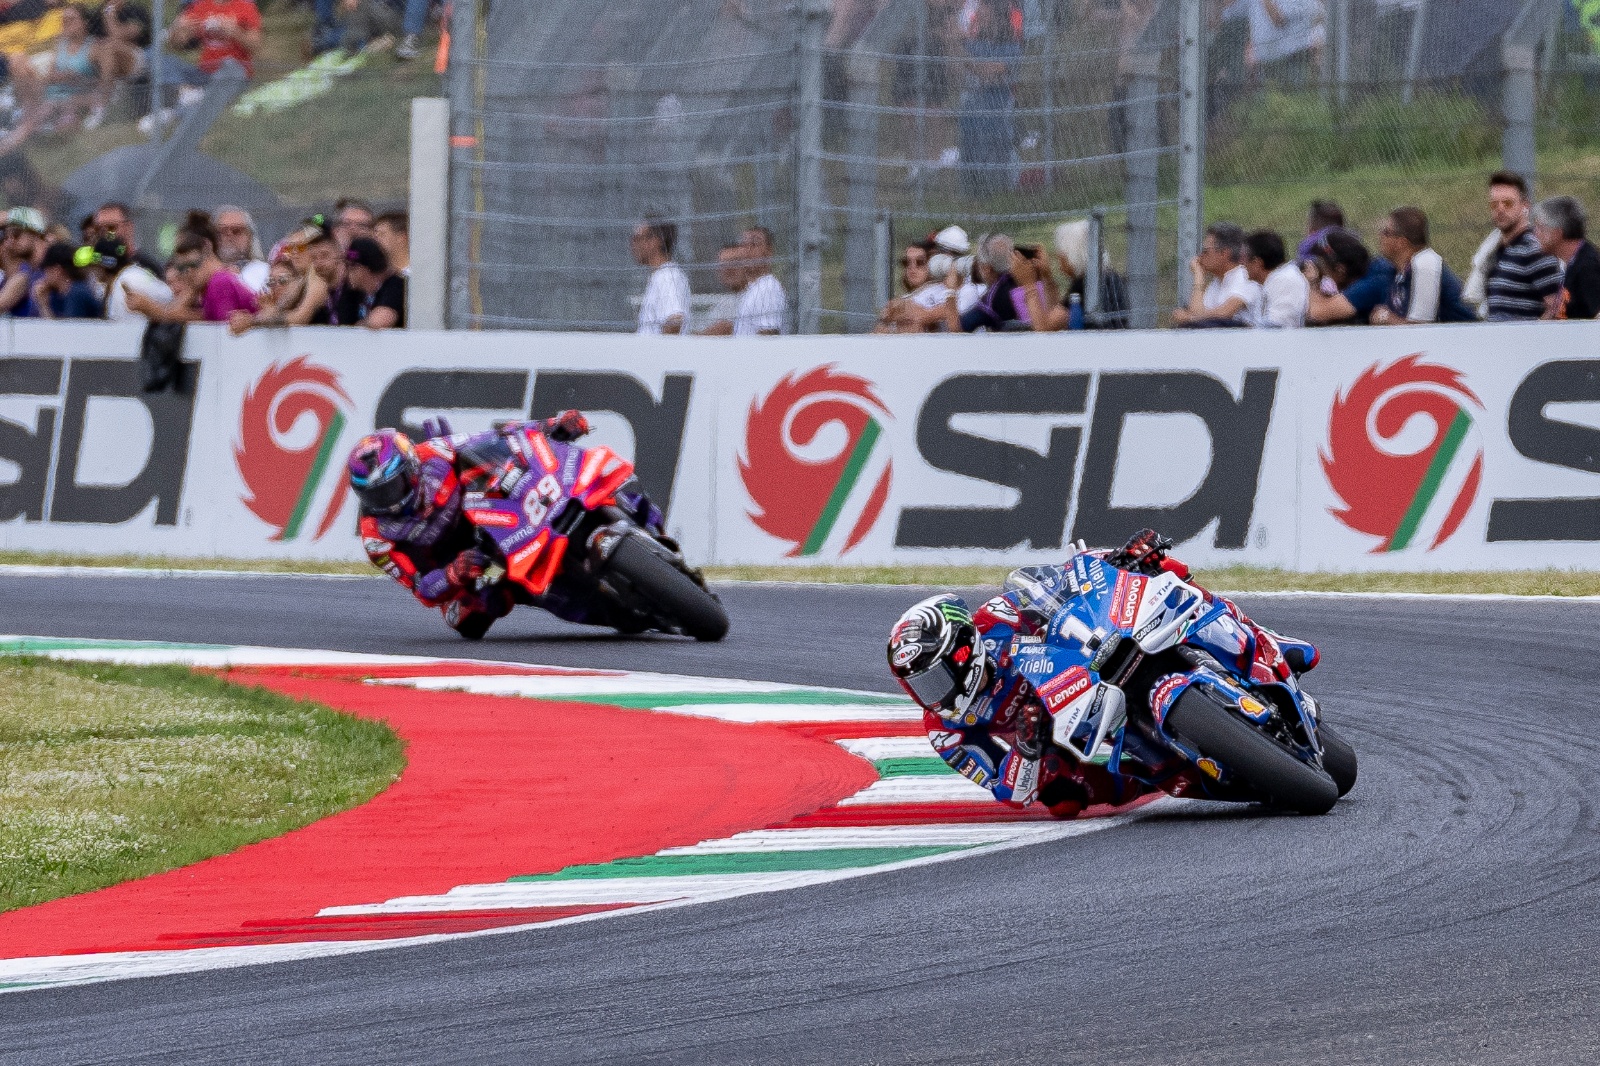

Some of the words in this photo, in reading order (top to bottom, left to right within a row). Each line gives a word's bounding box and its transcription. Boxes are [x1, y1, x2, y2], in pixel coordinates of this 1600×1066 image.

[523, 474, 562, 527] 89
[1121, 578, 1142, 625] Lenovo
[1157, 581, 1172, 596] TIM
[1059, 614, 1108, 658] 1
[1135, 617, 1161, 640] CARRERA
[1048, 677, 1088, 708] Lenovo
[1068, 707, 1081, 725] TIM
[1006, 755, 1019, 786] Lenovo
[1017, 760, 1034, 792] UnipolS
